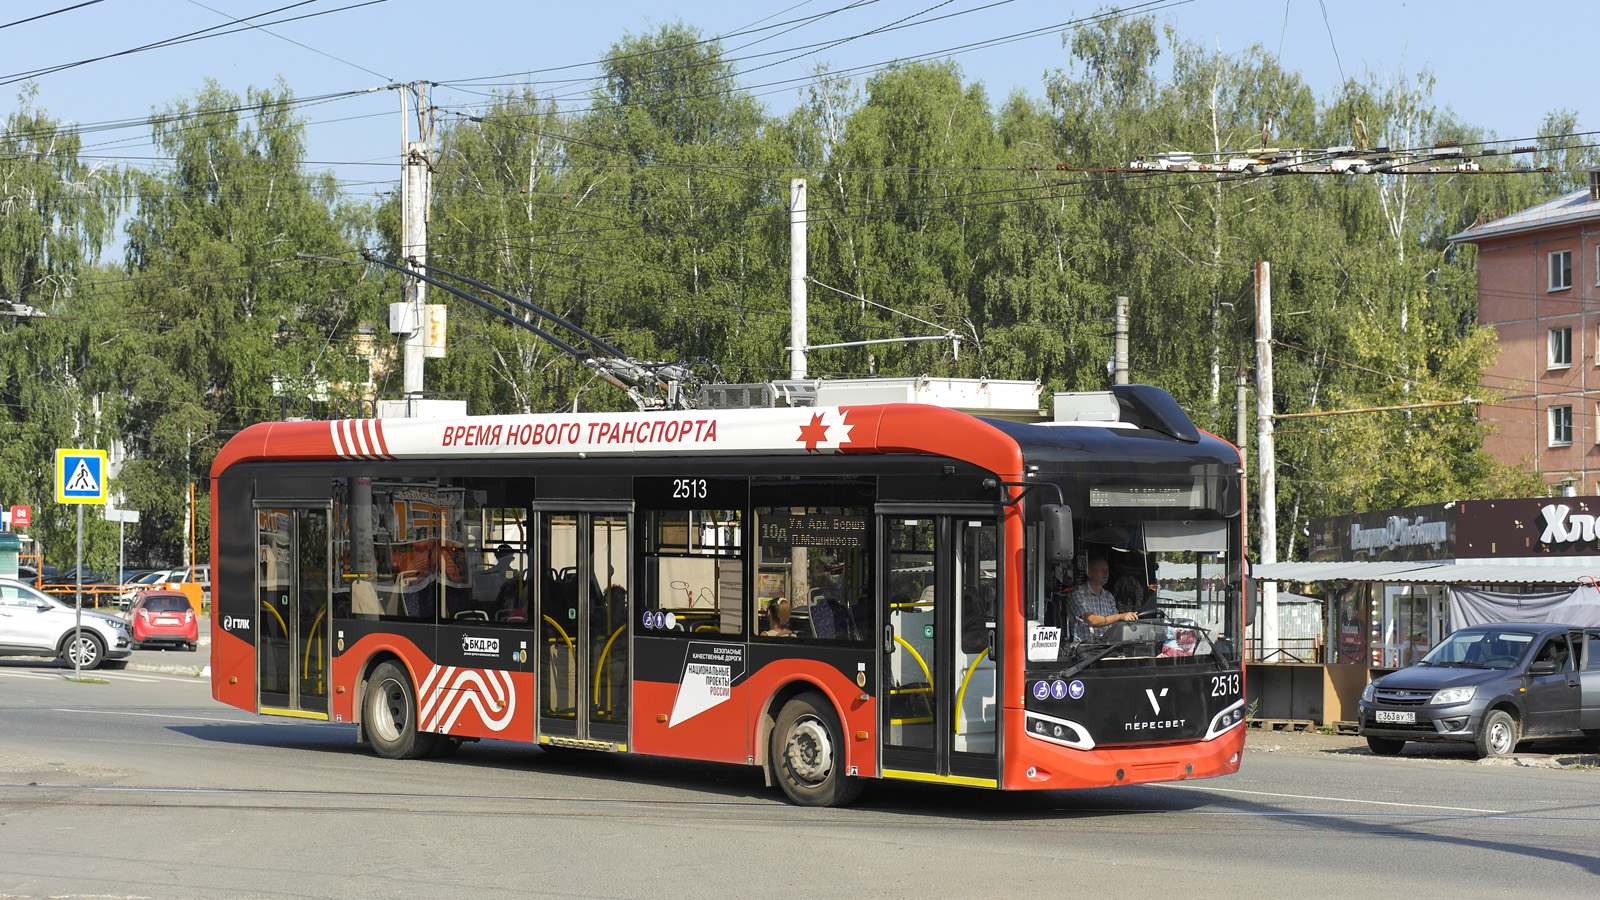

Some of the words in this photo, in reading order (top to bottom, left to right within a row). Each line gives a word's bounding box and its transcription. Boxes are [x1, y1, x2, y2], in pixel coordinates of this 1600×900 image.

[442, 424, 503, 447] ВРЕМЯ
[506, 422, 580, 446] НОВОГО
[587, 419, 717, 445] ТРАНСПОРТА
[672, 478, 708, 499] 2513
[1540, 504, 1600, 544] Хл
[232, 618, 250, 629] ГТЛК
[1039, 631, 1058, 640] ПАРК
[469, 639, 499, 651] БКД.РФ
[692, 653, 725, 661] КАЧЕСТВЕННЫЕ
[713, 647, 742, 656] БЕЗОПАСНЫЕ
[688, 664, 730, 677] НАЦИОНАЛЬНЫЕ
[705, 675, 730, 687] ПРОЕКТЫ
[1211, 674, 1240, 697] 2513
[709, 686, 730, 697] РОССИИ
[1406, 712, 1414, 720] 18
[1125, 719, 1186, 730] ПЕРЕСВЕТ
